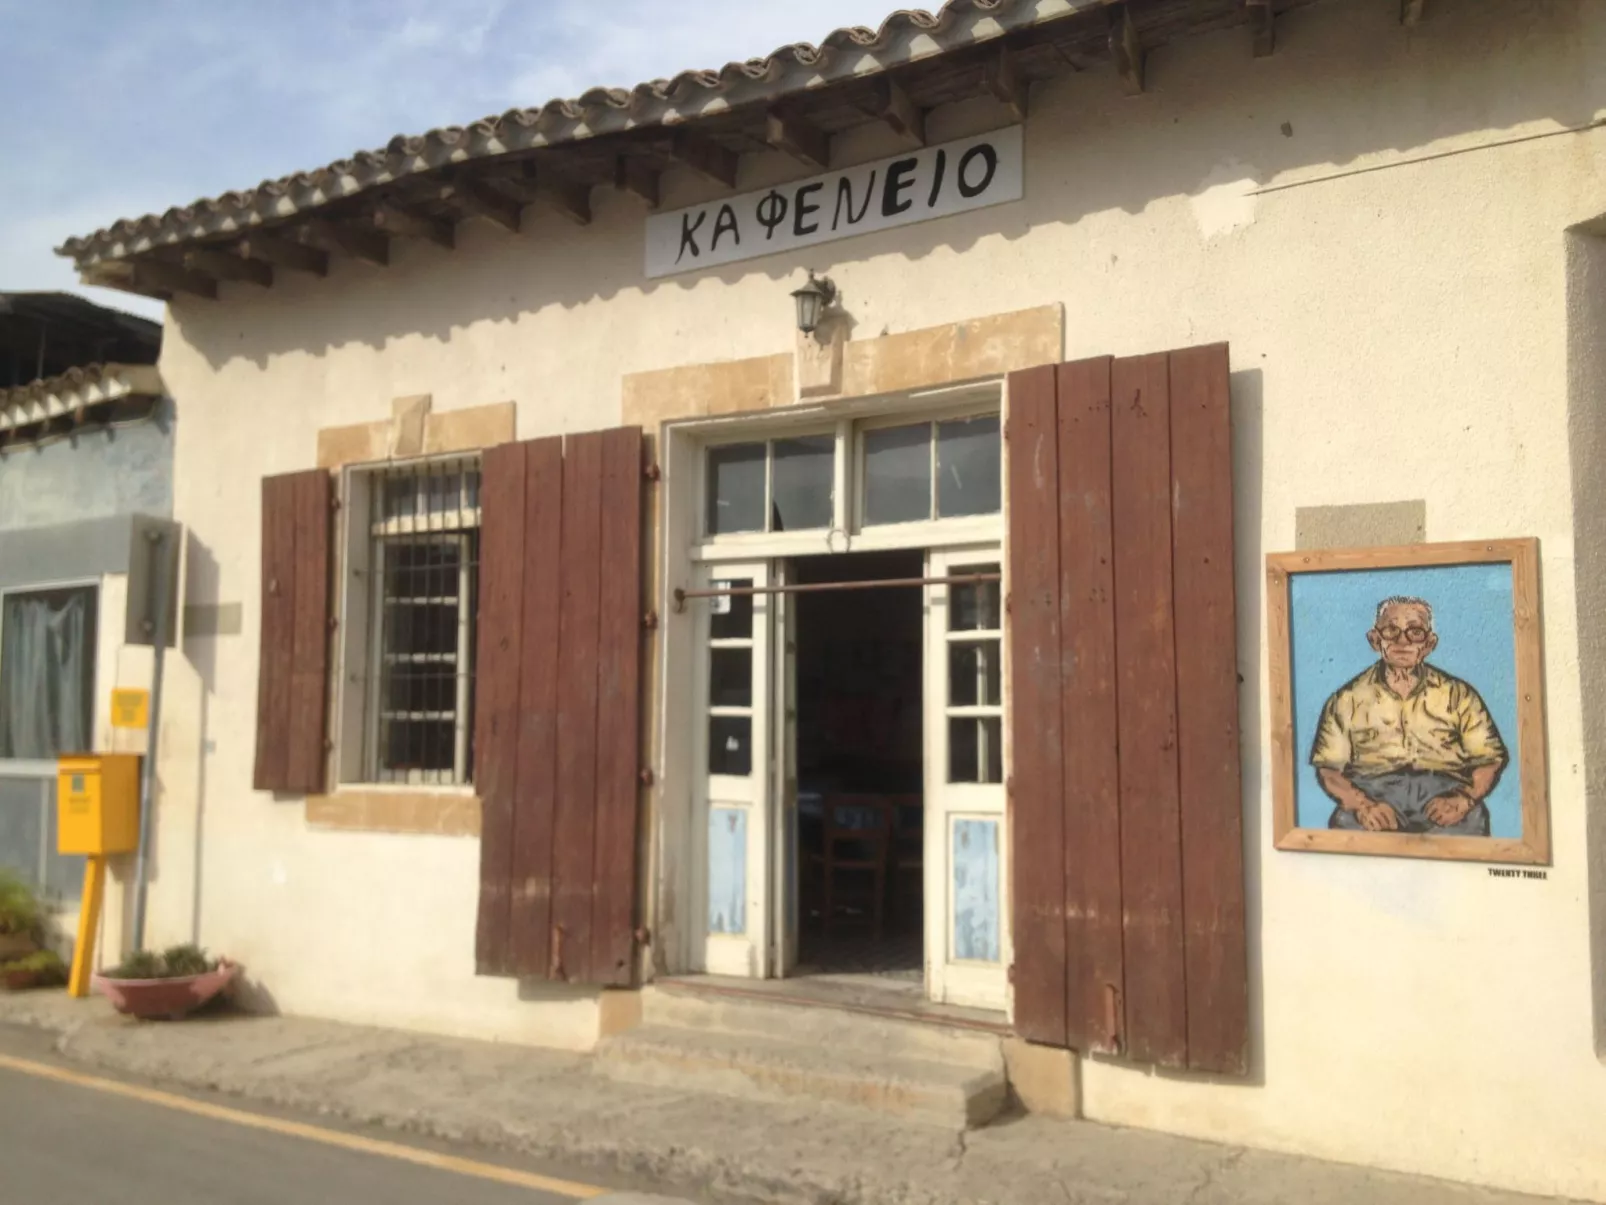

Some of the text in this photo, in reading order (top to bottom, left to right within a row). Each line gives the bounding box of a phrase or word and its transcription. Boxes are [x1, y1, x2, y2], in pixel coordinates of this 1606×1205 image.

[676, 143, 998, 265] ΚΑΦΕΝΕΙΟ
[1487, 867, 1548, 880] TWENTY THREE
